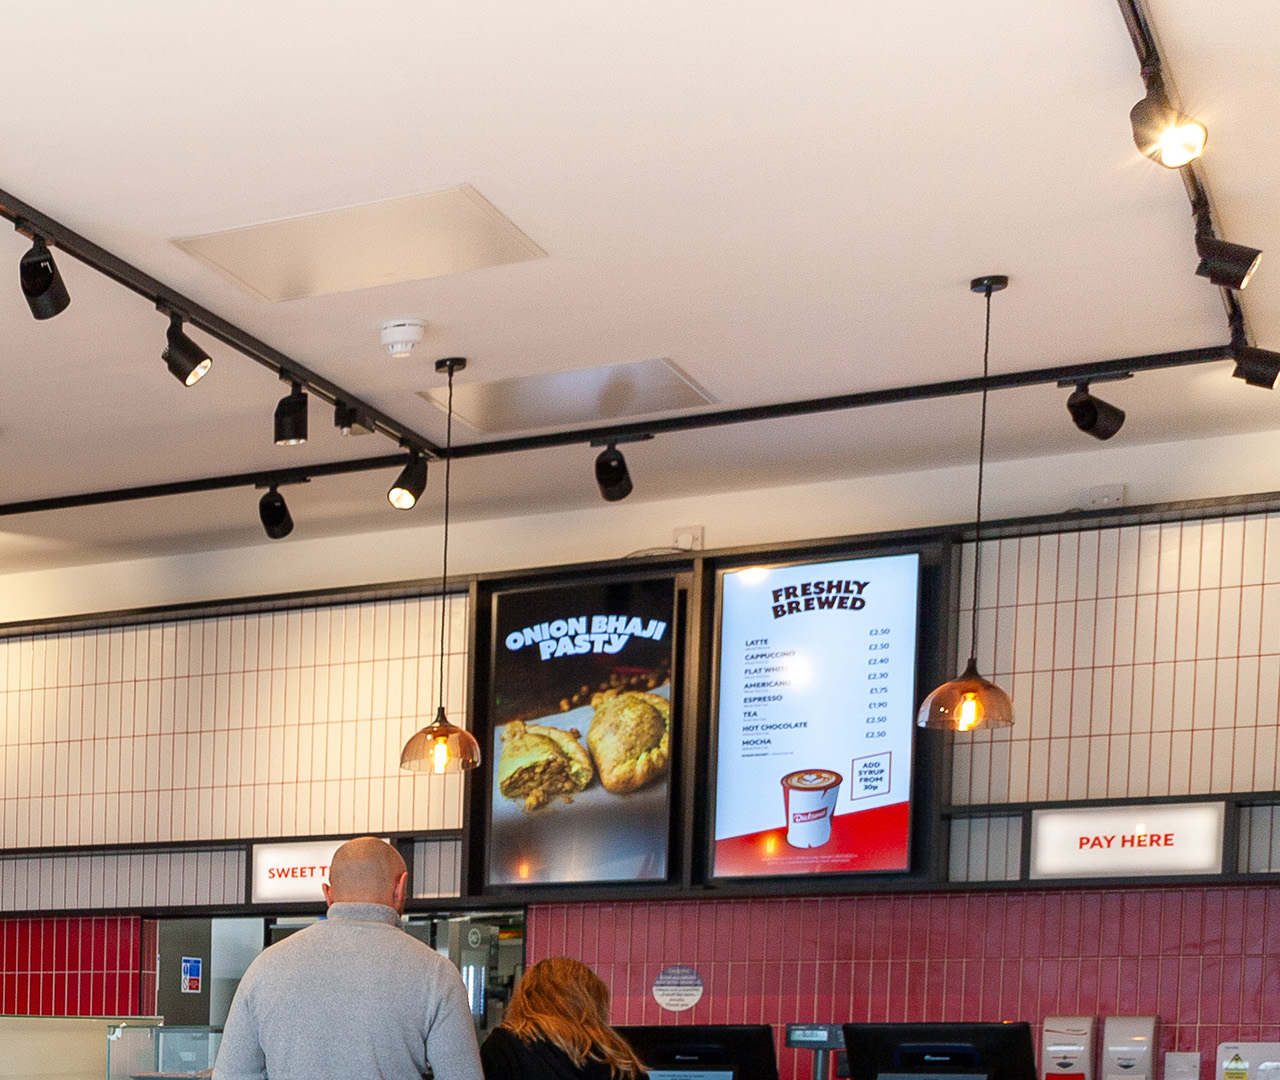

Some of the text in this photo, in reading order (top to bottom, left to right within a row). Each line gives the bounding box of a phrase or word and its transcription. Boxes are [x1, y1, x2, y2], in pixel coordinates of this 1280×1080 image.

[771, 579, 871, 604] FRESHLY
[771, 596, 866, 620] BREWED
[505, 615, 667, 651] ONION BHAJI
[539, 633, 631, 661] PASTY
[745, 638, 768, 647] LATTE
[744, 667, 762, 675] FLAT
[743, 695, 783, 703] ESPRESSO
[761, 722, 807, 731] CHOCOLATE
[742, 738, 772, 746] MOCHA
[862, 761, 881, 769] ADD
[858, 769, 885, 777] SYRUP
[1078, 833, 1175, 850] PAY HERE
[268, 866, 316, 879] SWEET
